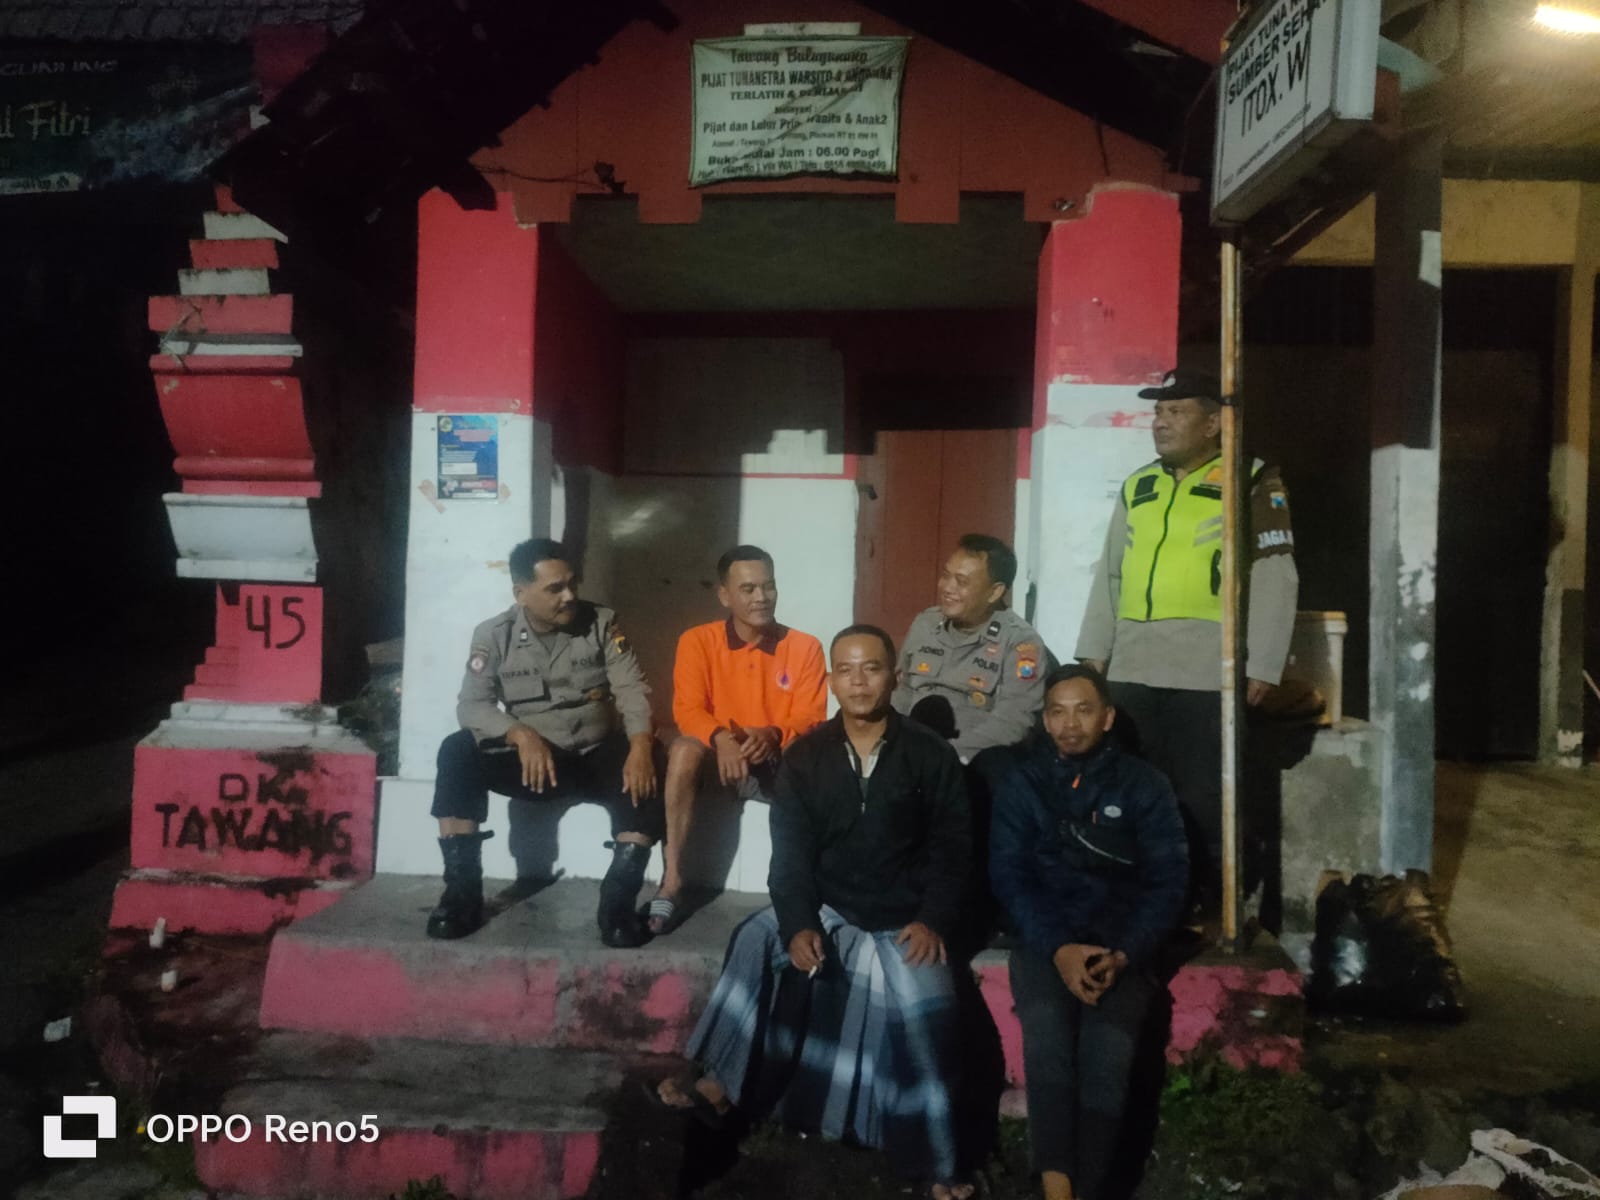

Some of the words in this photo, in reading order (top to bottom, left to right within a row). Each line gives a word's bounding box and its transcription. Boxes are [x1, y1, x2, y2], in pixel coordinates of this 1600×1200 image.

[1258, 3, 1287, 46] TUNA
[701, 72, 726, 88] PIJAT
[789, 67, 832, 85] WARSITO
[1229, 34, 1280, 104] SUMBER
[1287, 30, 1310, 91] W
[18, 100, 90, 141] Fitri
[703, 121, 726, 134] Pijat
[729, 121, 748, 131] dan
[751, 119, 776, 131] Lulur
[845, 112, 853, 124] &
[856, 113, 887, 125] Anak2
[779, 146, 804, 158] Jam
[816, 147, 849, 157] 06.00
[853, 147, 880, 159] Pagi
[246, 595, 306, 648] 45
[973, 657, 999, 672] POLRI
[155, 803, 353, 852] TAWANG
